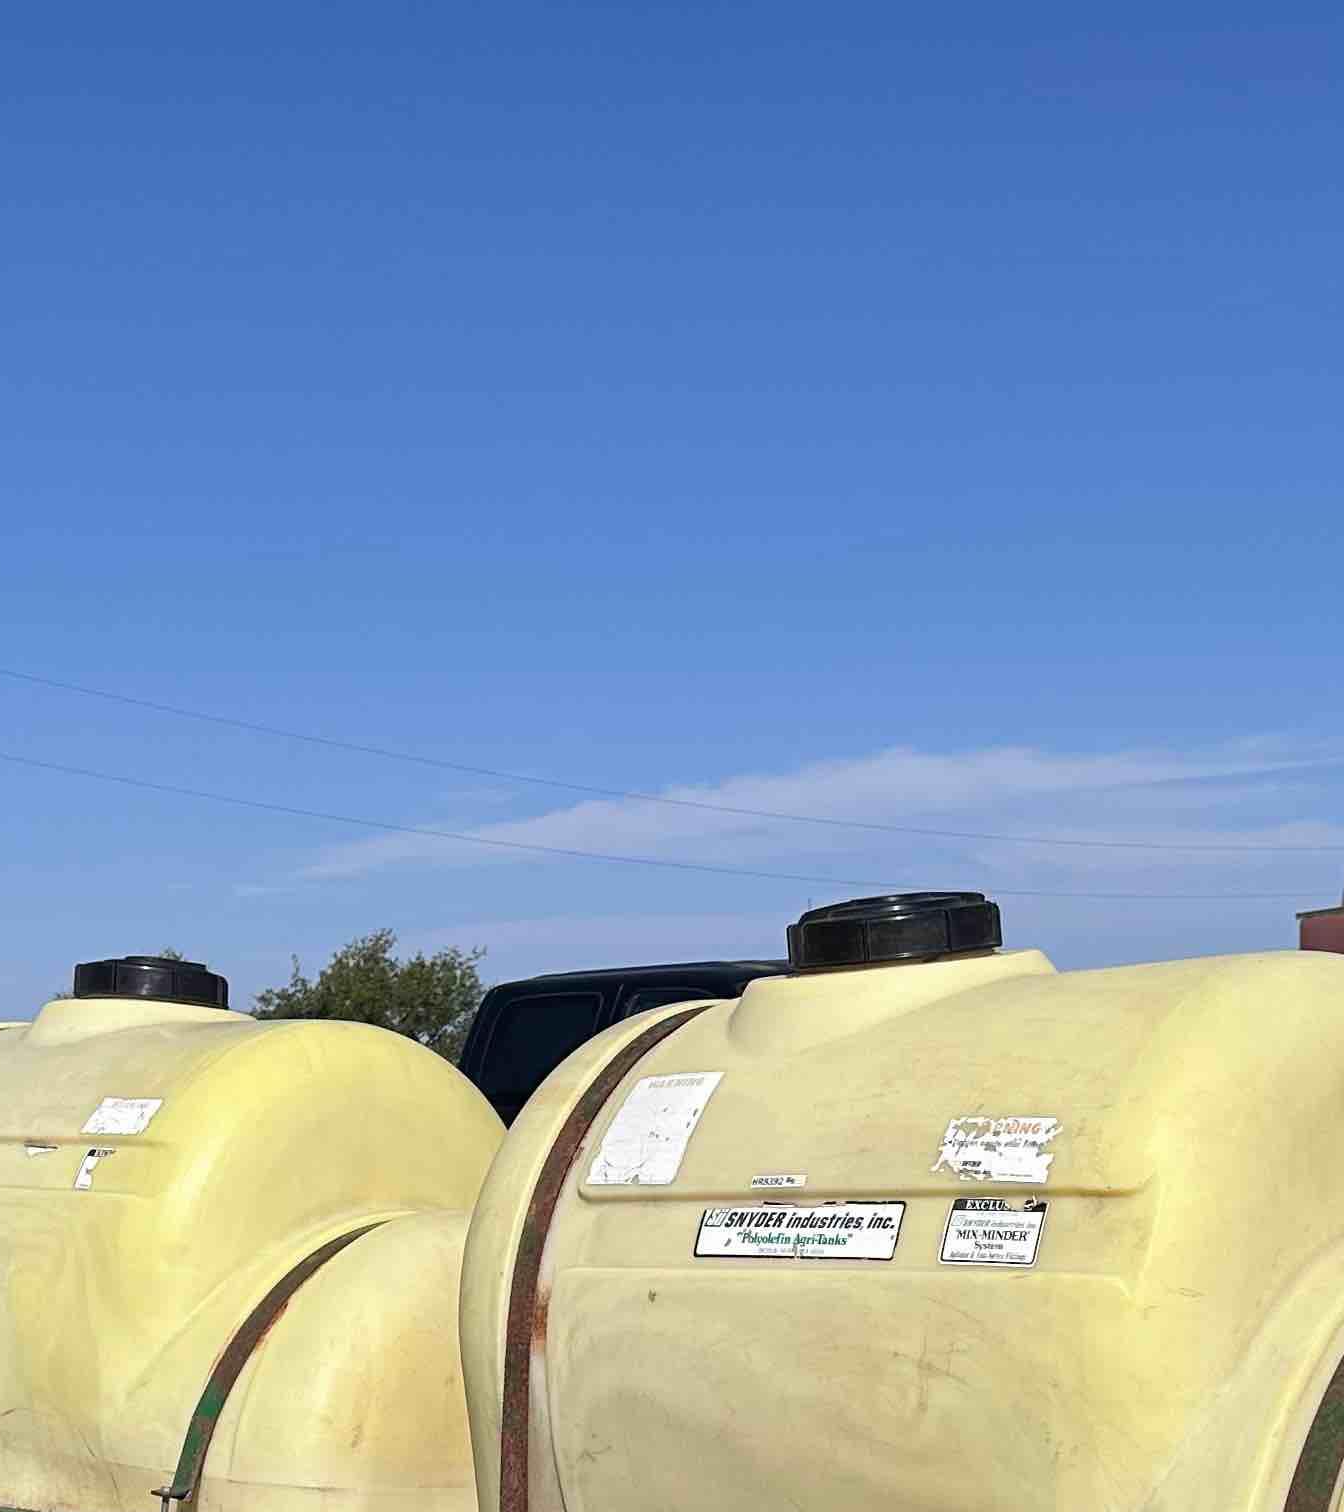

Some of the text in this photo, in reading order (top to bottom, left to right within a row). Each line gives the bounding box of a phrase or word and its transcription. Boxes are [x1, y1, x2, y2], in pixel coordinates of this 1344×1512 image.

[725, 1211, 896, 1231] SNYDER industries, inc.
[974, 1240, 1004, 1251] System
